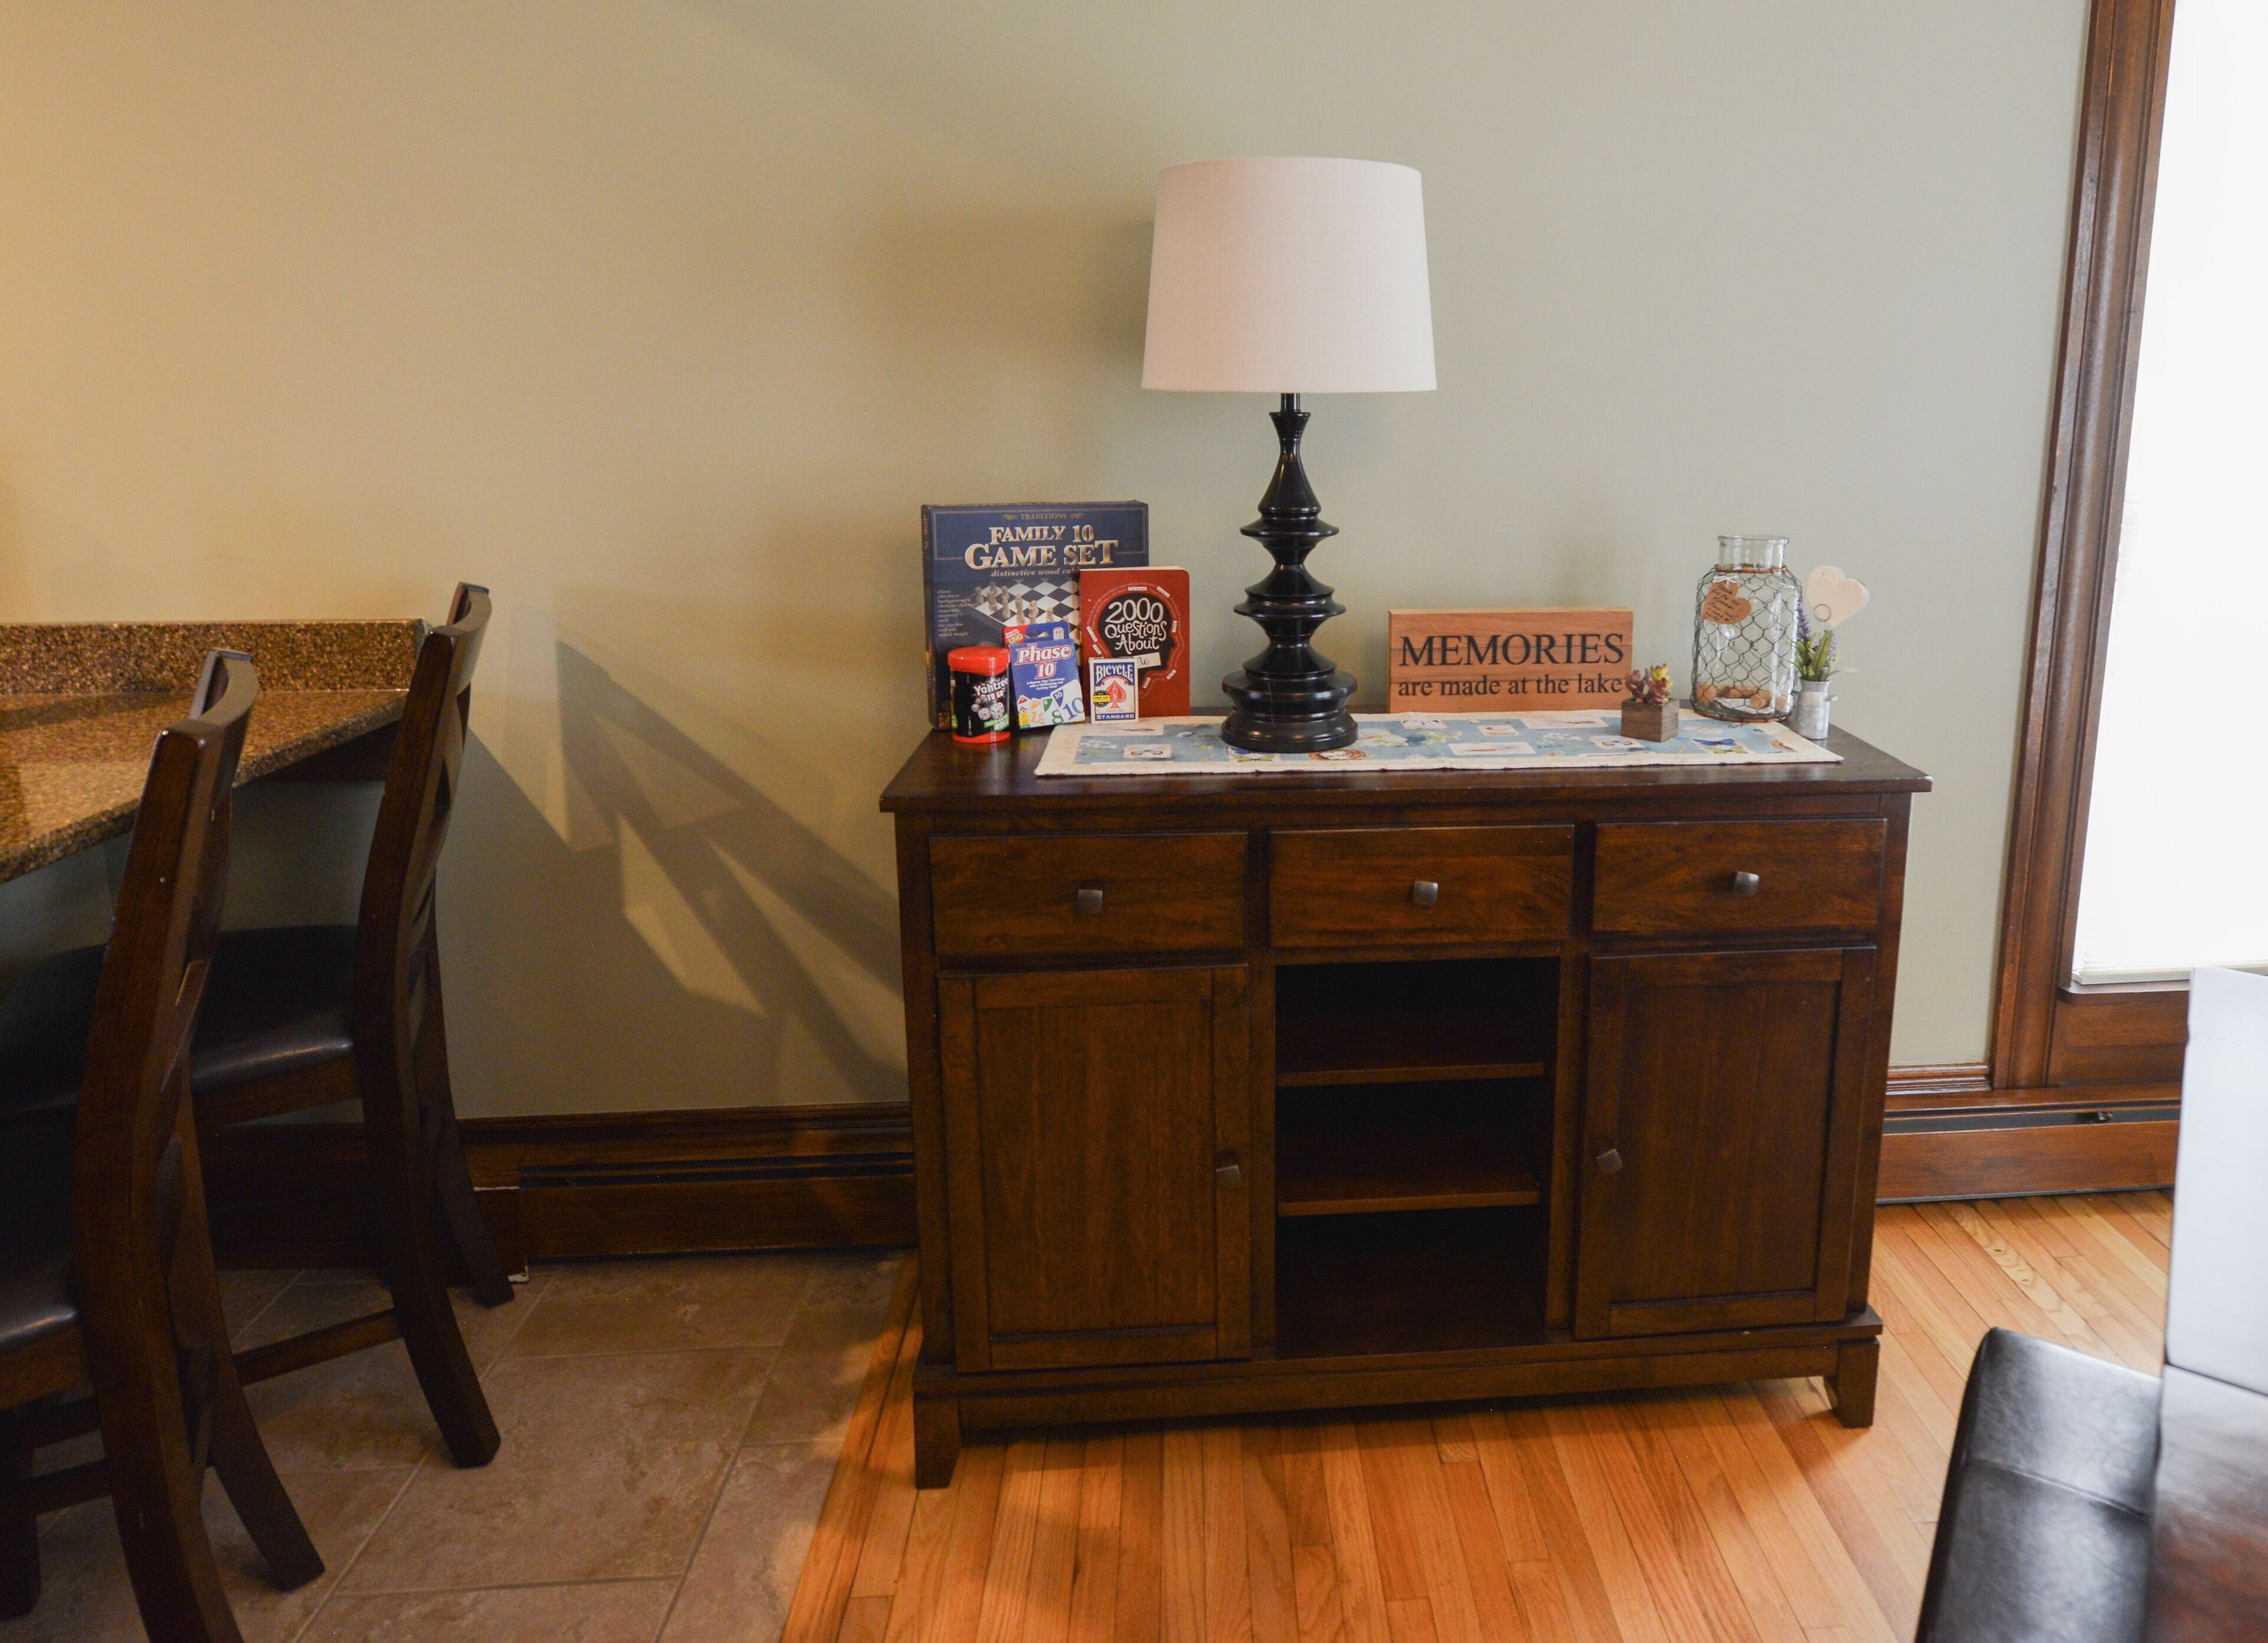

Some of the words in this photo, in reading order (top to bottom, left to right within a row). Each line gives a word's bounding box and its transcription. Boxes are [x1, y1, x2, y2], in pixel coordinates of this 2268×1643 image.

[989, 525, 1066, 545] FAMILY
[1072, 525, 1095, 543] 10
[964, 543, 1057, 570] GAME
[1064, 540, 1119, 565] SET
[991, 568, 1036, 577] distinctive
[1038, 568, 1060, 576] wood
[1105, 598, 1164, 624] 2000
[1008, 633, 1023, 644] UNO
[1105, 620, 1166, 641] Questions
[1014, 643, 1071, 665] Phase
[1115, 634, 1159, 655] About
[1399, 633, 1624, 666] MEMORIES
[1035, 661, 1057, 680] 10
[1096, 664, 1133, 685] BICYCLE
[1054, 691, 1063, 700] 10
[1398, 681, 1432, 697] are
[1440, 675, 1500, 696] made
[1508, 678, 1529, 695] at
[1536, 674, 1569, 694] the
[1577, 674, 1622, 694] lake
